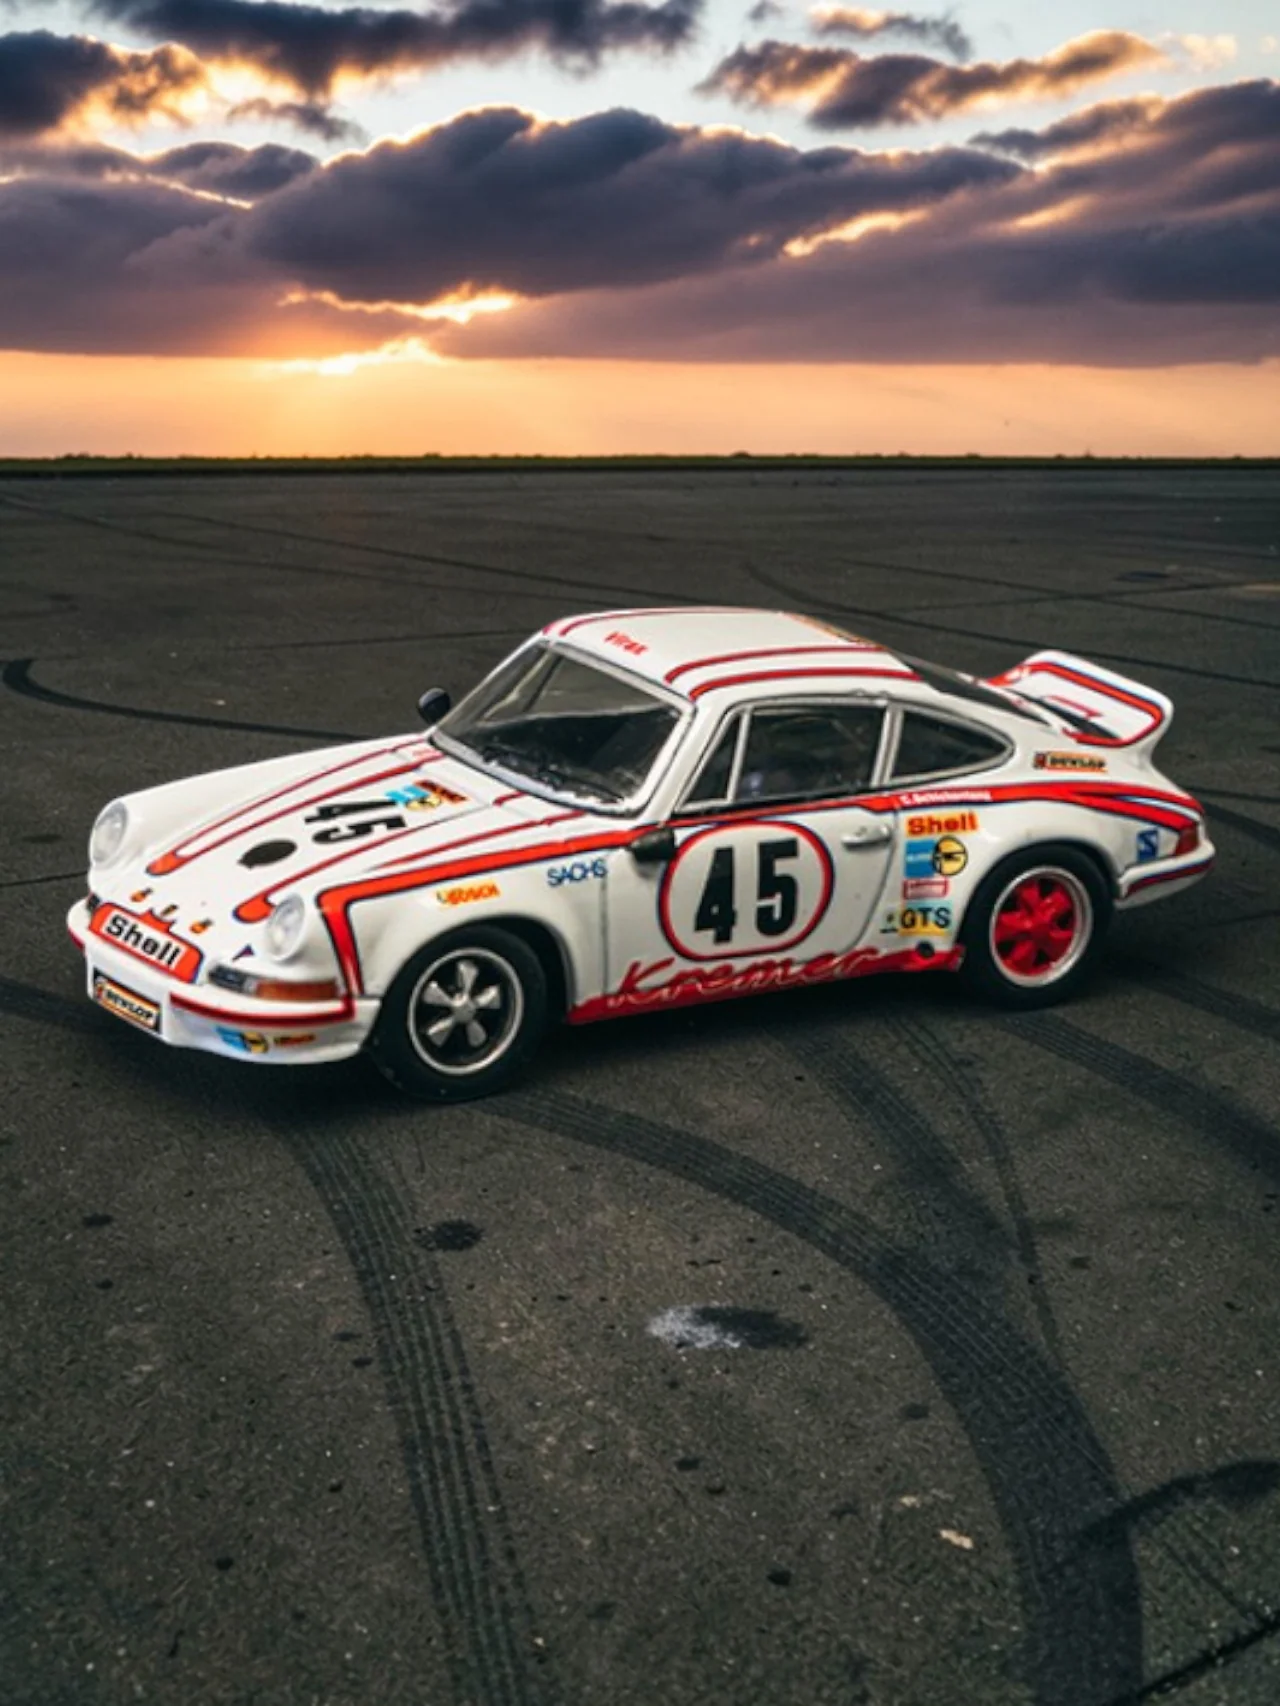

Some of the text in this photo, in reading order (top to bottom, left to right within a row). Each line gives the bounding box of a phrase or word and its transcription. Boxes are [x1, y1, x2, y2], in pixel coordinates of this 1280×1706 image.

[304, 800, 407, 844] 45
[907, 811, 977, 836] Shell
[547, 858, 608, 888] SACHS
[694, 838, 800, 944] 45
[105, 913, 181, 966] Shell
[901, 907, 951, 929] GTS
[608, 945, 884, 1006] Kremer
